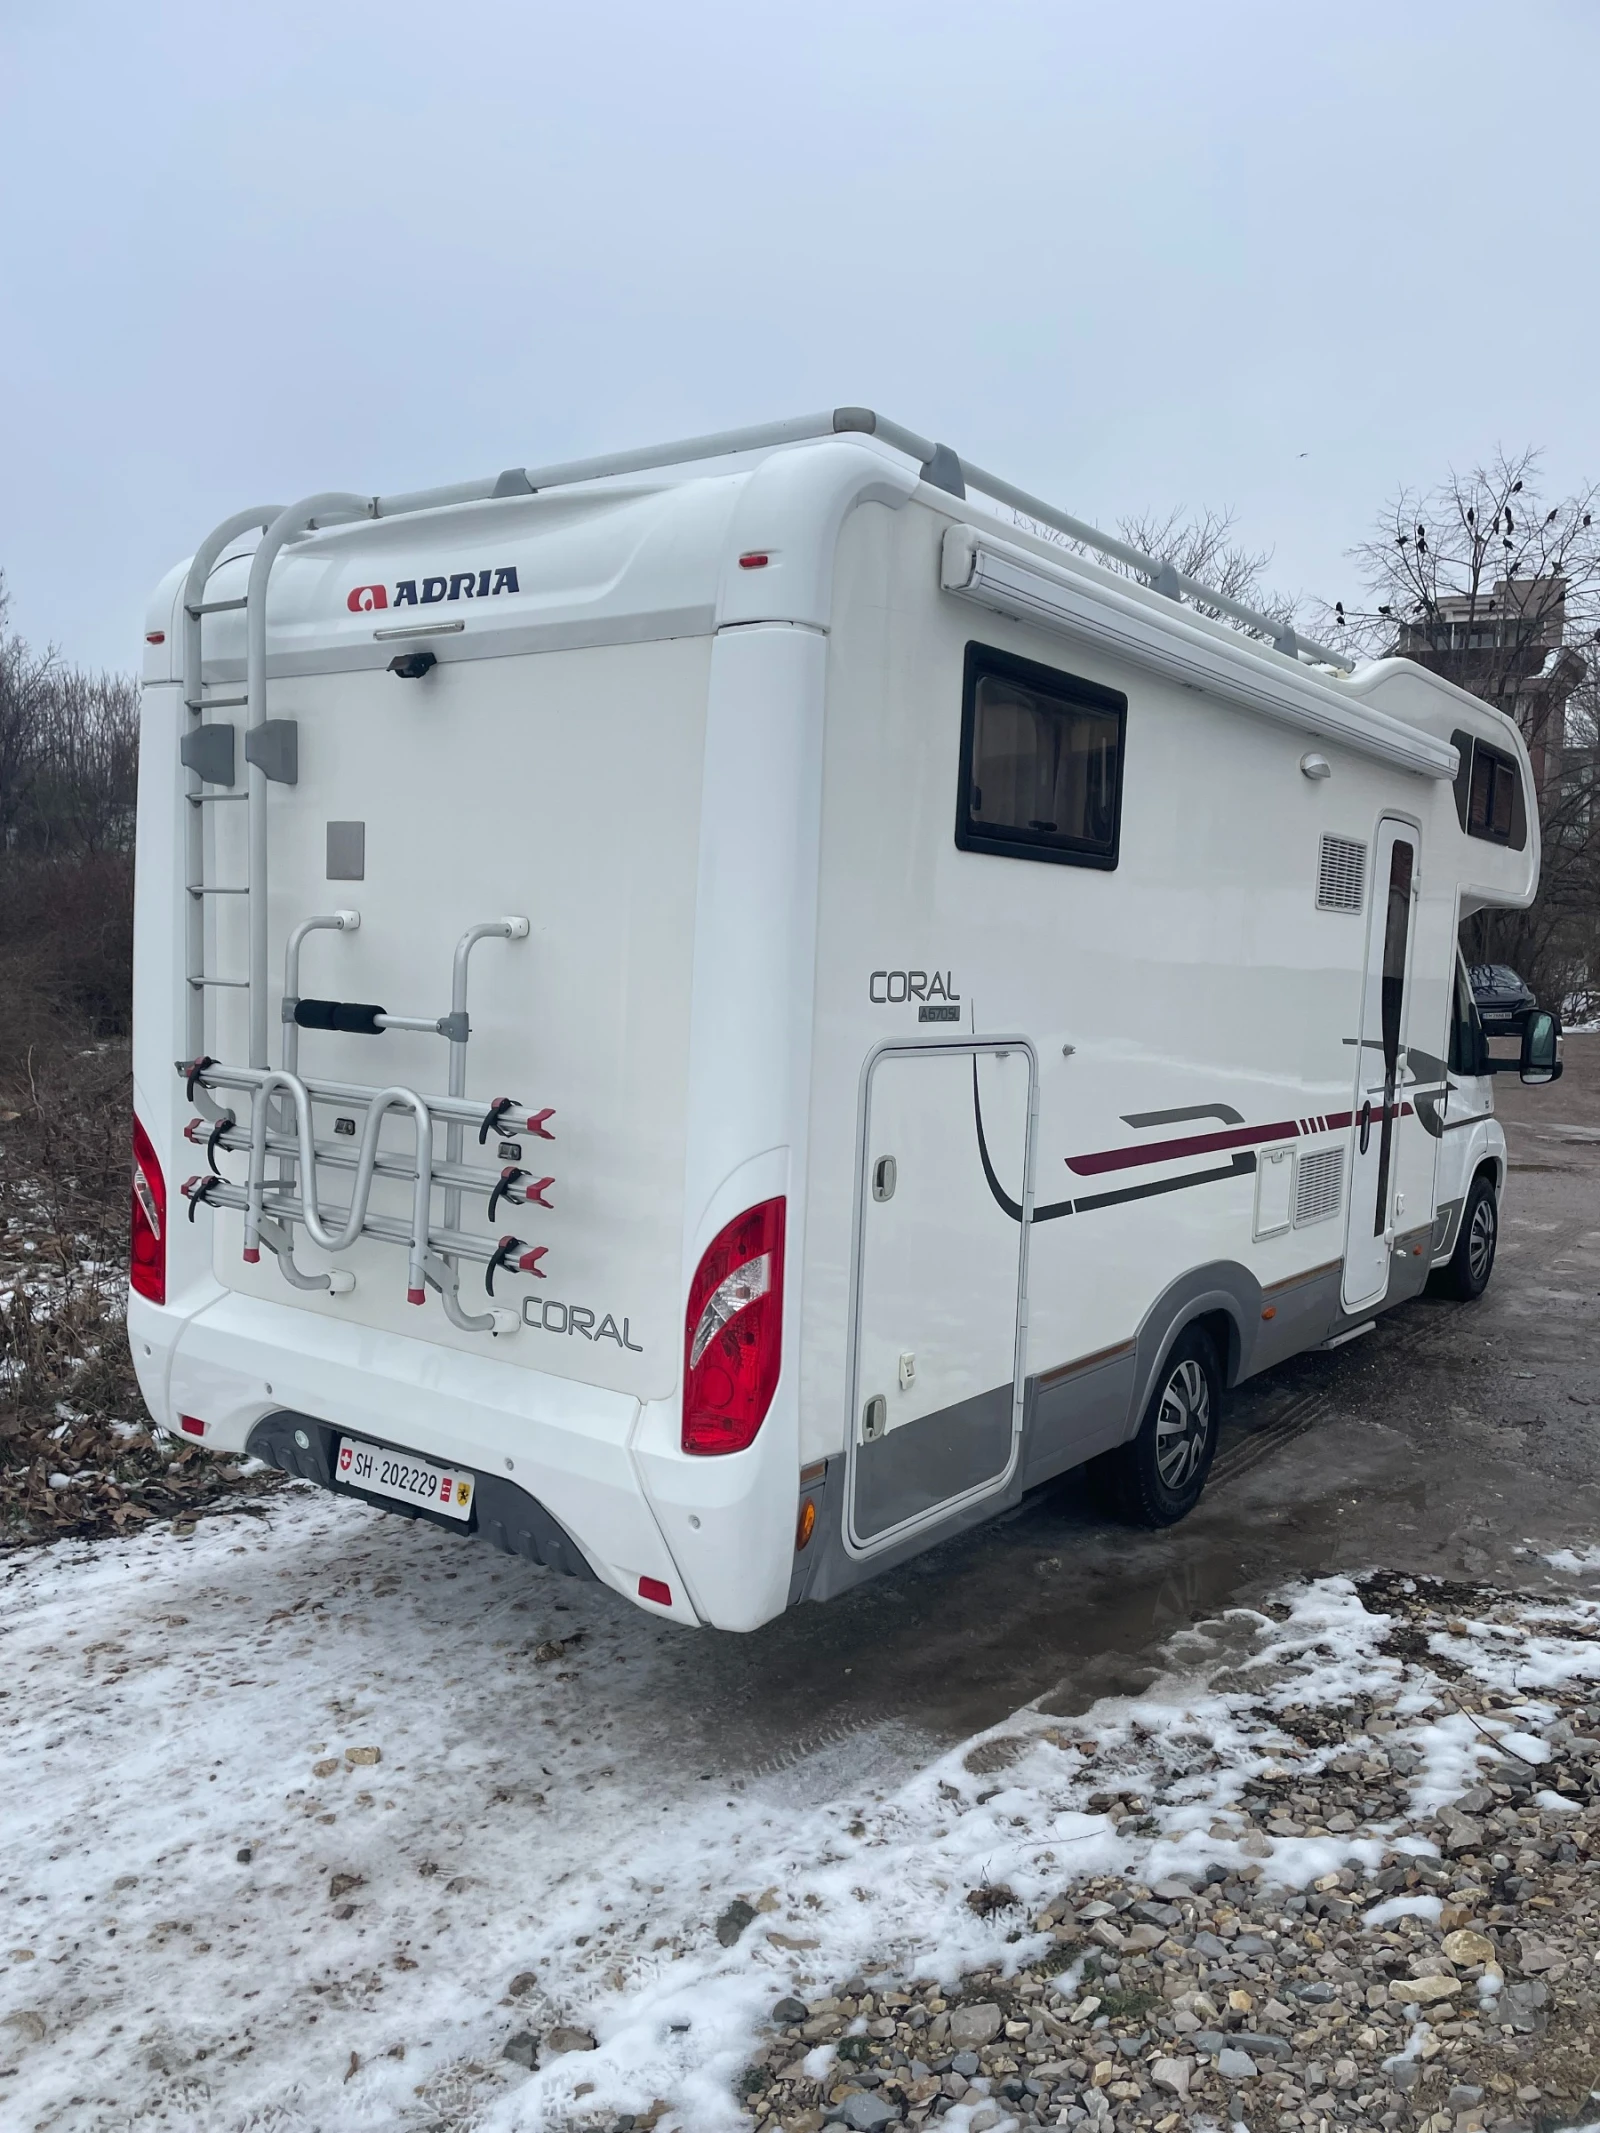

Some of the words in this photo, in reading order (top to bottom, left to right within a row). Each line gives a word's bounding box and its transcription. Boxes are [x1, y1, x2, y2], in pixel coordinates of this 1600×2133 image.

[393, 566, 520, 608] ADRIA
[869, 970, 961, 1004] CORAL
[920, 1007, 960, 1021] A670SL
[522, 1295, 644, 1353] CORAL
